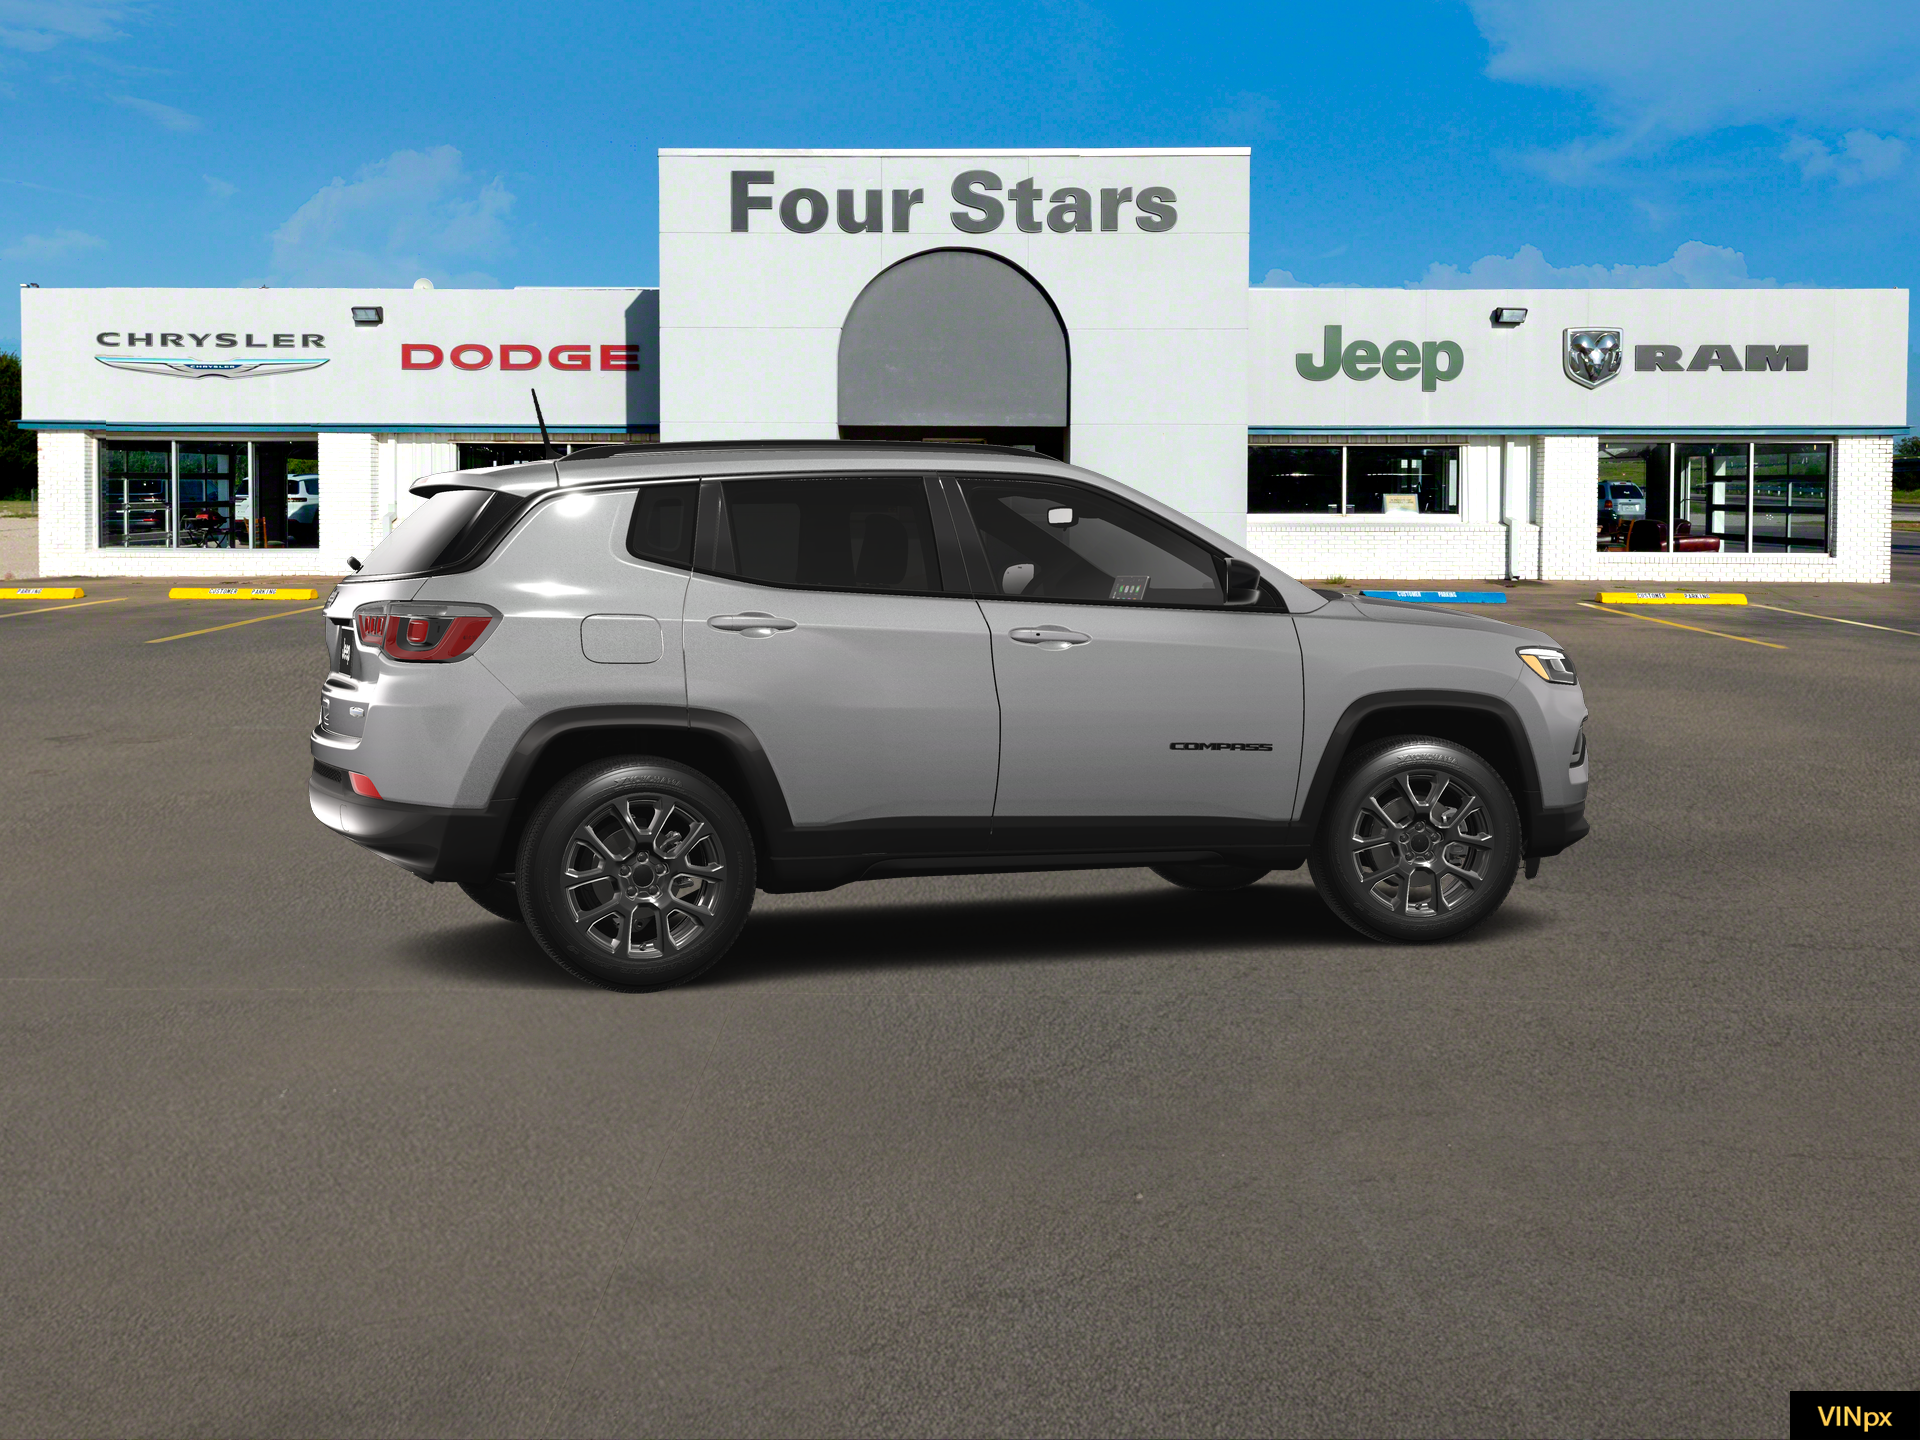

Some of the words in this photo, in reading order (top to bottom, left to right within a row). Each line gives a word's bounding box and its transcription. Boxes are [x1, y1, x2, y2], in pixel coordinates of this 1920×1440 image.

[730, 170, 924, 234] Four
[949, 169, 1178, 234] Stars
[96, 331, 326, 348] CHRYSLER
[401, 343, 640, 372] DODGE
[1295, 324, 1464, 392] Jeep
[1634, 344, 1809, 372] RAM
[1169, 742, 1274, 752] COMPASS
